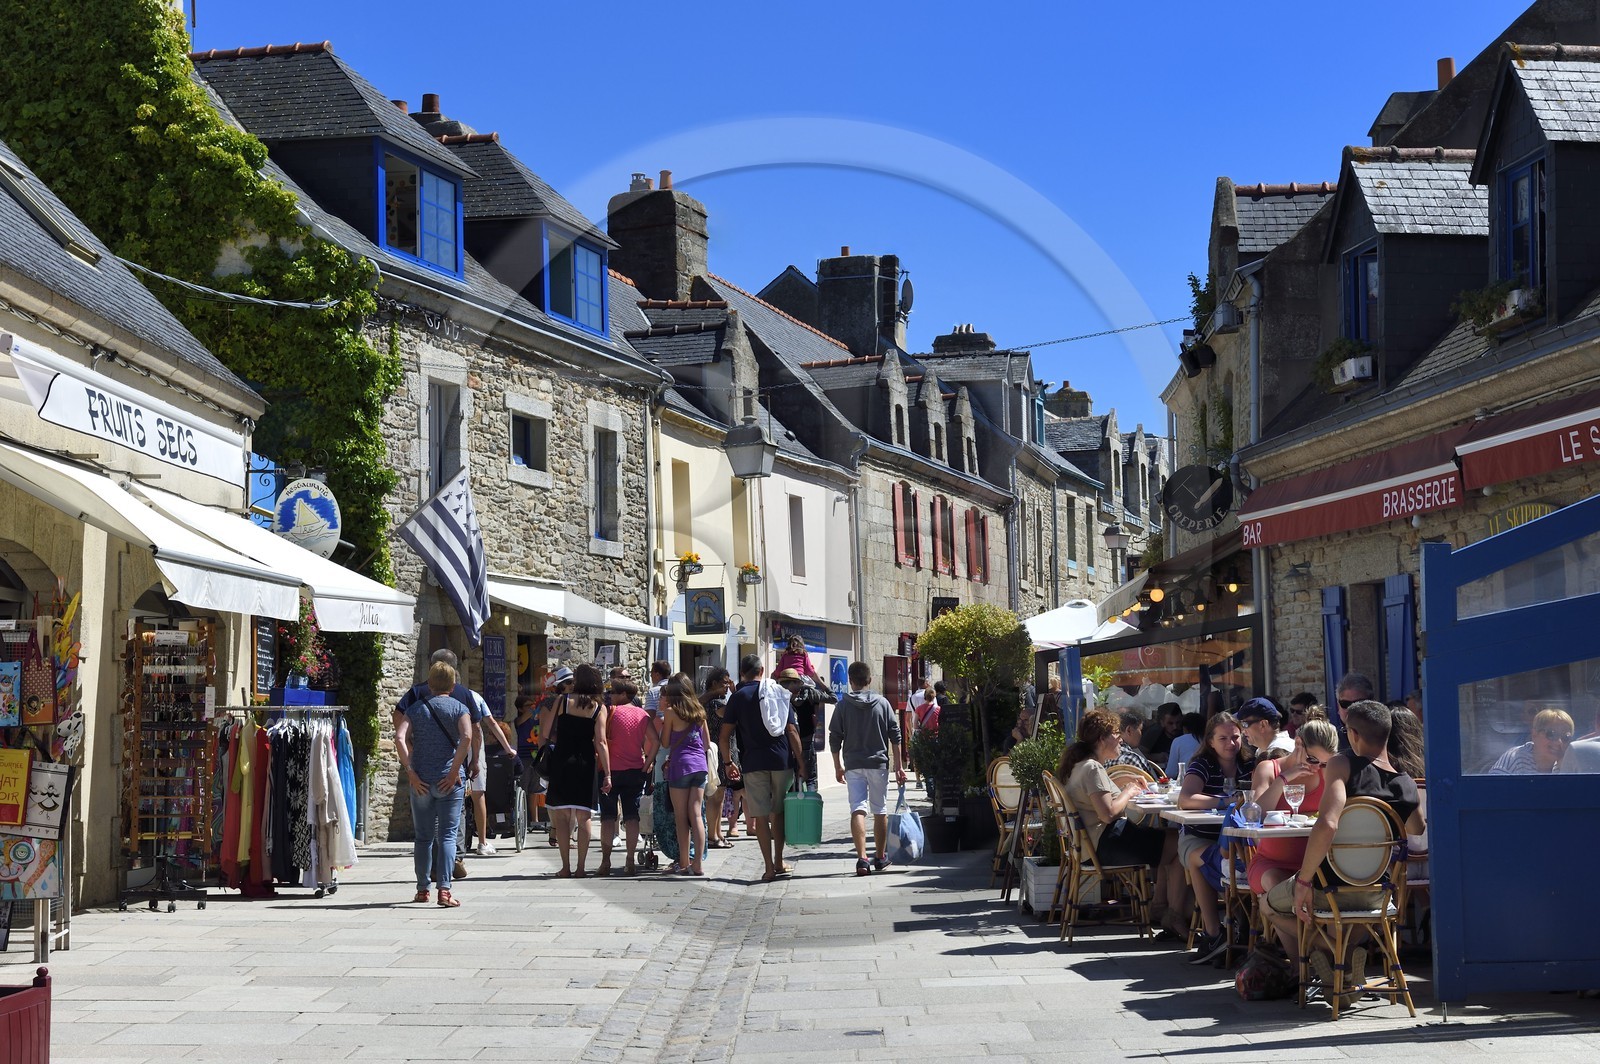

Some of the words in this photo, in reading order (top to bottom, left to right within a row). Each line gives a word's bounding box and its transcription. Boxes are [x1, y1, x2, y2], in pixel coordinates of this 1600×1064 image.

[85, 387, 146, 448] FRUITS
[156, 417, 198, 466] SECS
[1559, 430, 1584, 463] LE
[1382, 476, 1457, 518] BRASSERIE
[1243, 522, 1262, 546] BAR
